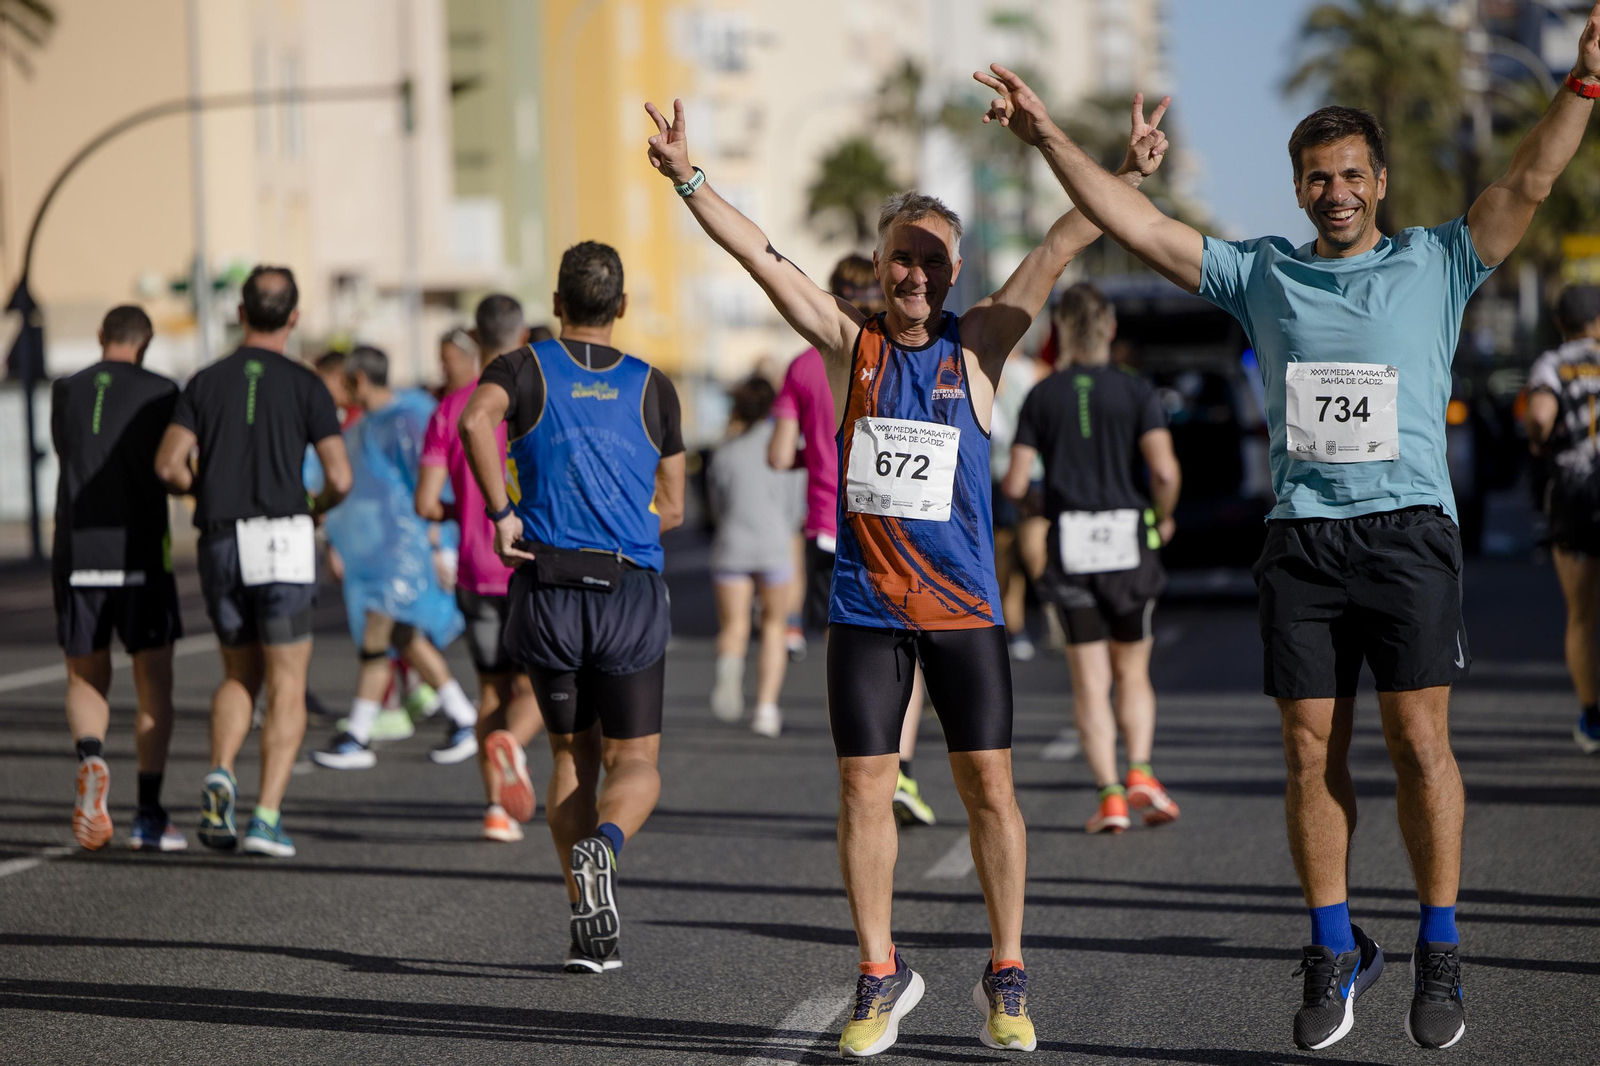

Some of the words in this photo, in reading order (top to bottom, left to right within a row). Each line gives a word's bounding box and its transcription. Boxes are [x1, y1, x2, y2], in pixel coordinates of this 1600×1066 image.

[1310, 368, 1329, 376] XXXV
[1330, 368, 1355, 376] MEDIA
[1356, 369, 1396, 378] MARATÓN
[1346, 377, 1357, 385] DE
[1358, 376, 1384, 386] CÁDIZ
[1315, 396, 1371, 422] 734
[874, 424, 892, 432] XXXV
[893, 425, 918, 434] MEDIA
[908, 435, 919, 443] DE
[875, 451, 931, 480] 672
